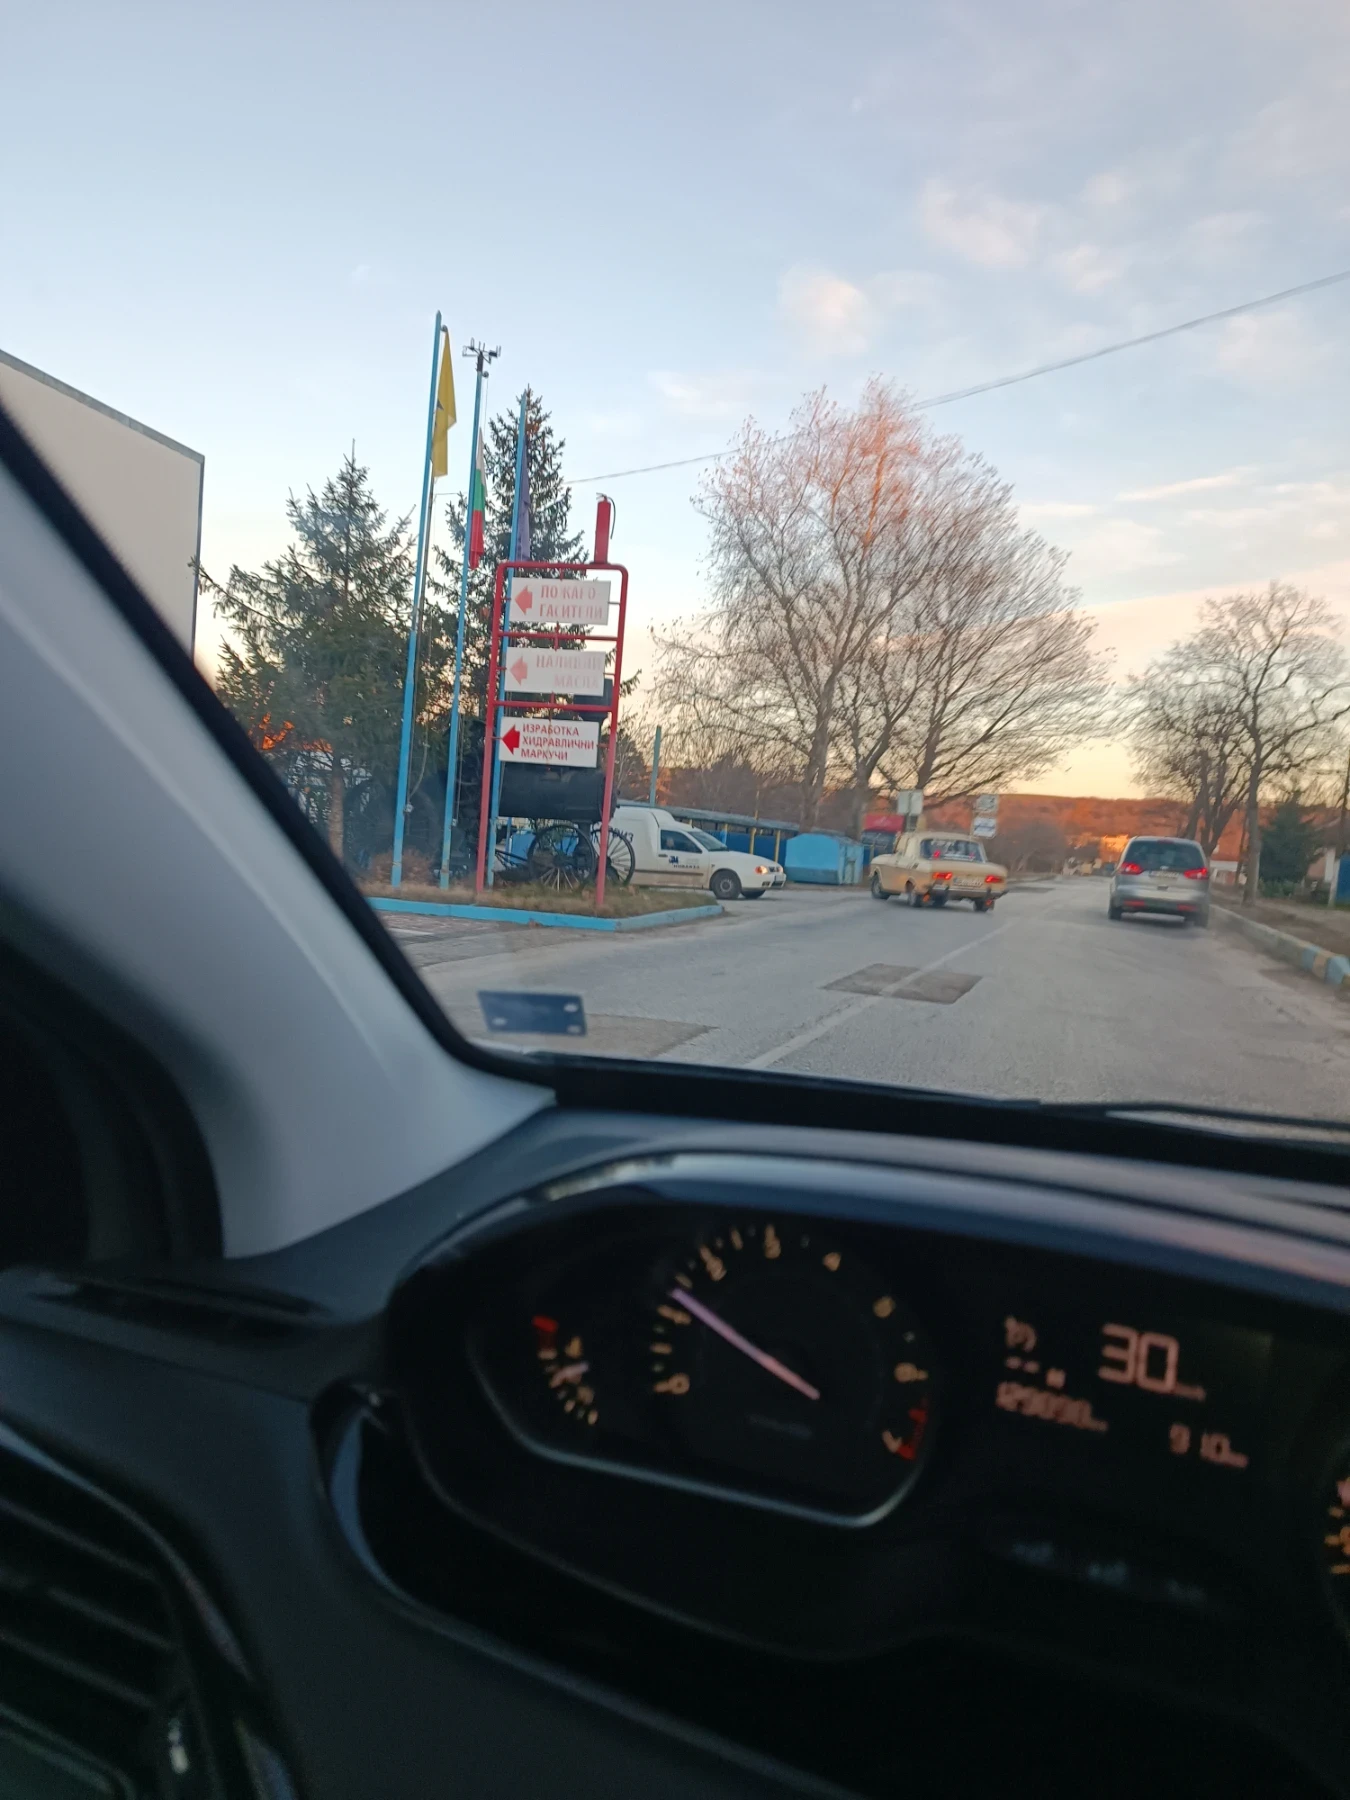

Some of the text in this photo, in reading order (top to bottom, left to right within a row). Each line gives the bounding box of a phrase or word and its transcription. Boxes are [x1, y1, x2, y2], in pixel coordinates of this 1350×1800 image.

[522, 723, 580, 736] ИЗРАБОТКА
[522, 736, 594, 750] ХИДРАВЛИЧНИ
[520, 748, 568, 761] МАРКУЧИ
[1098, 1322, 1179, 1394] 30
